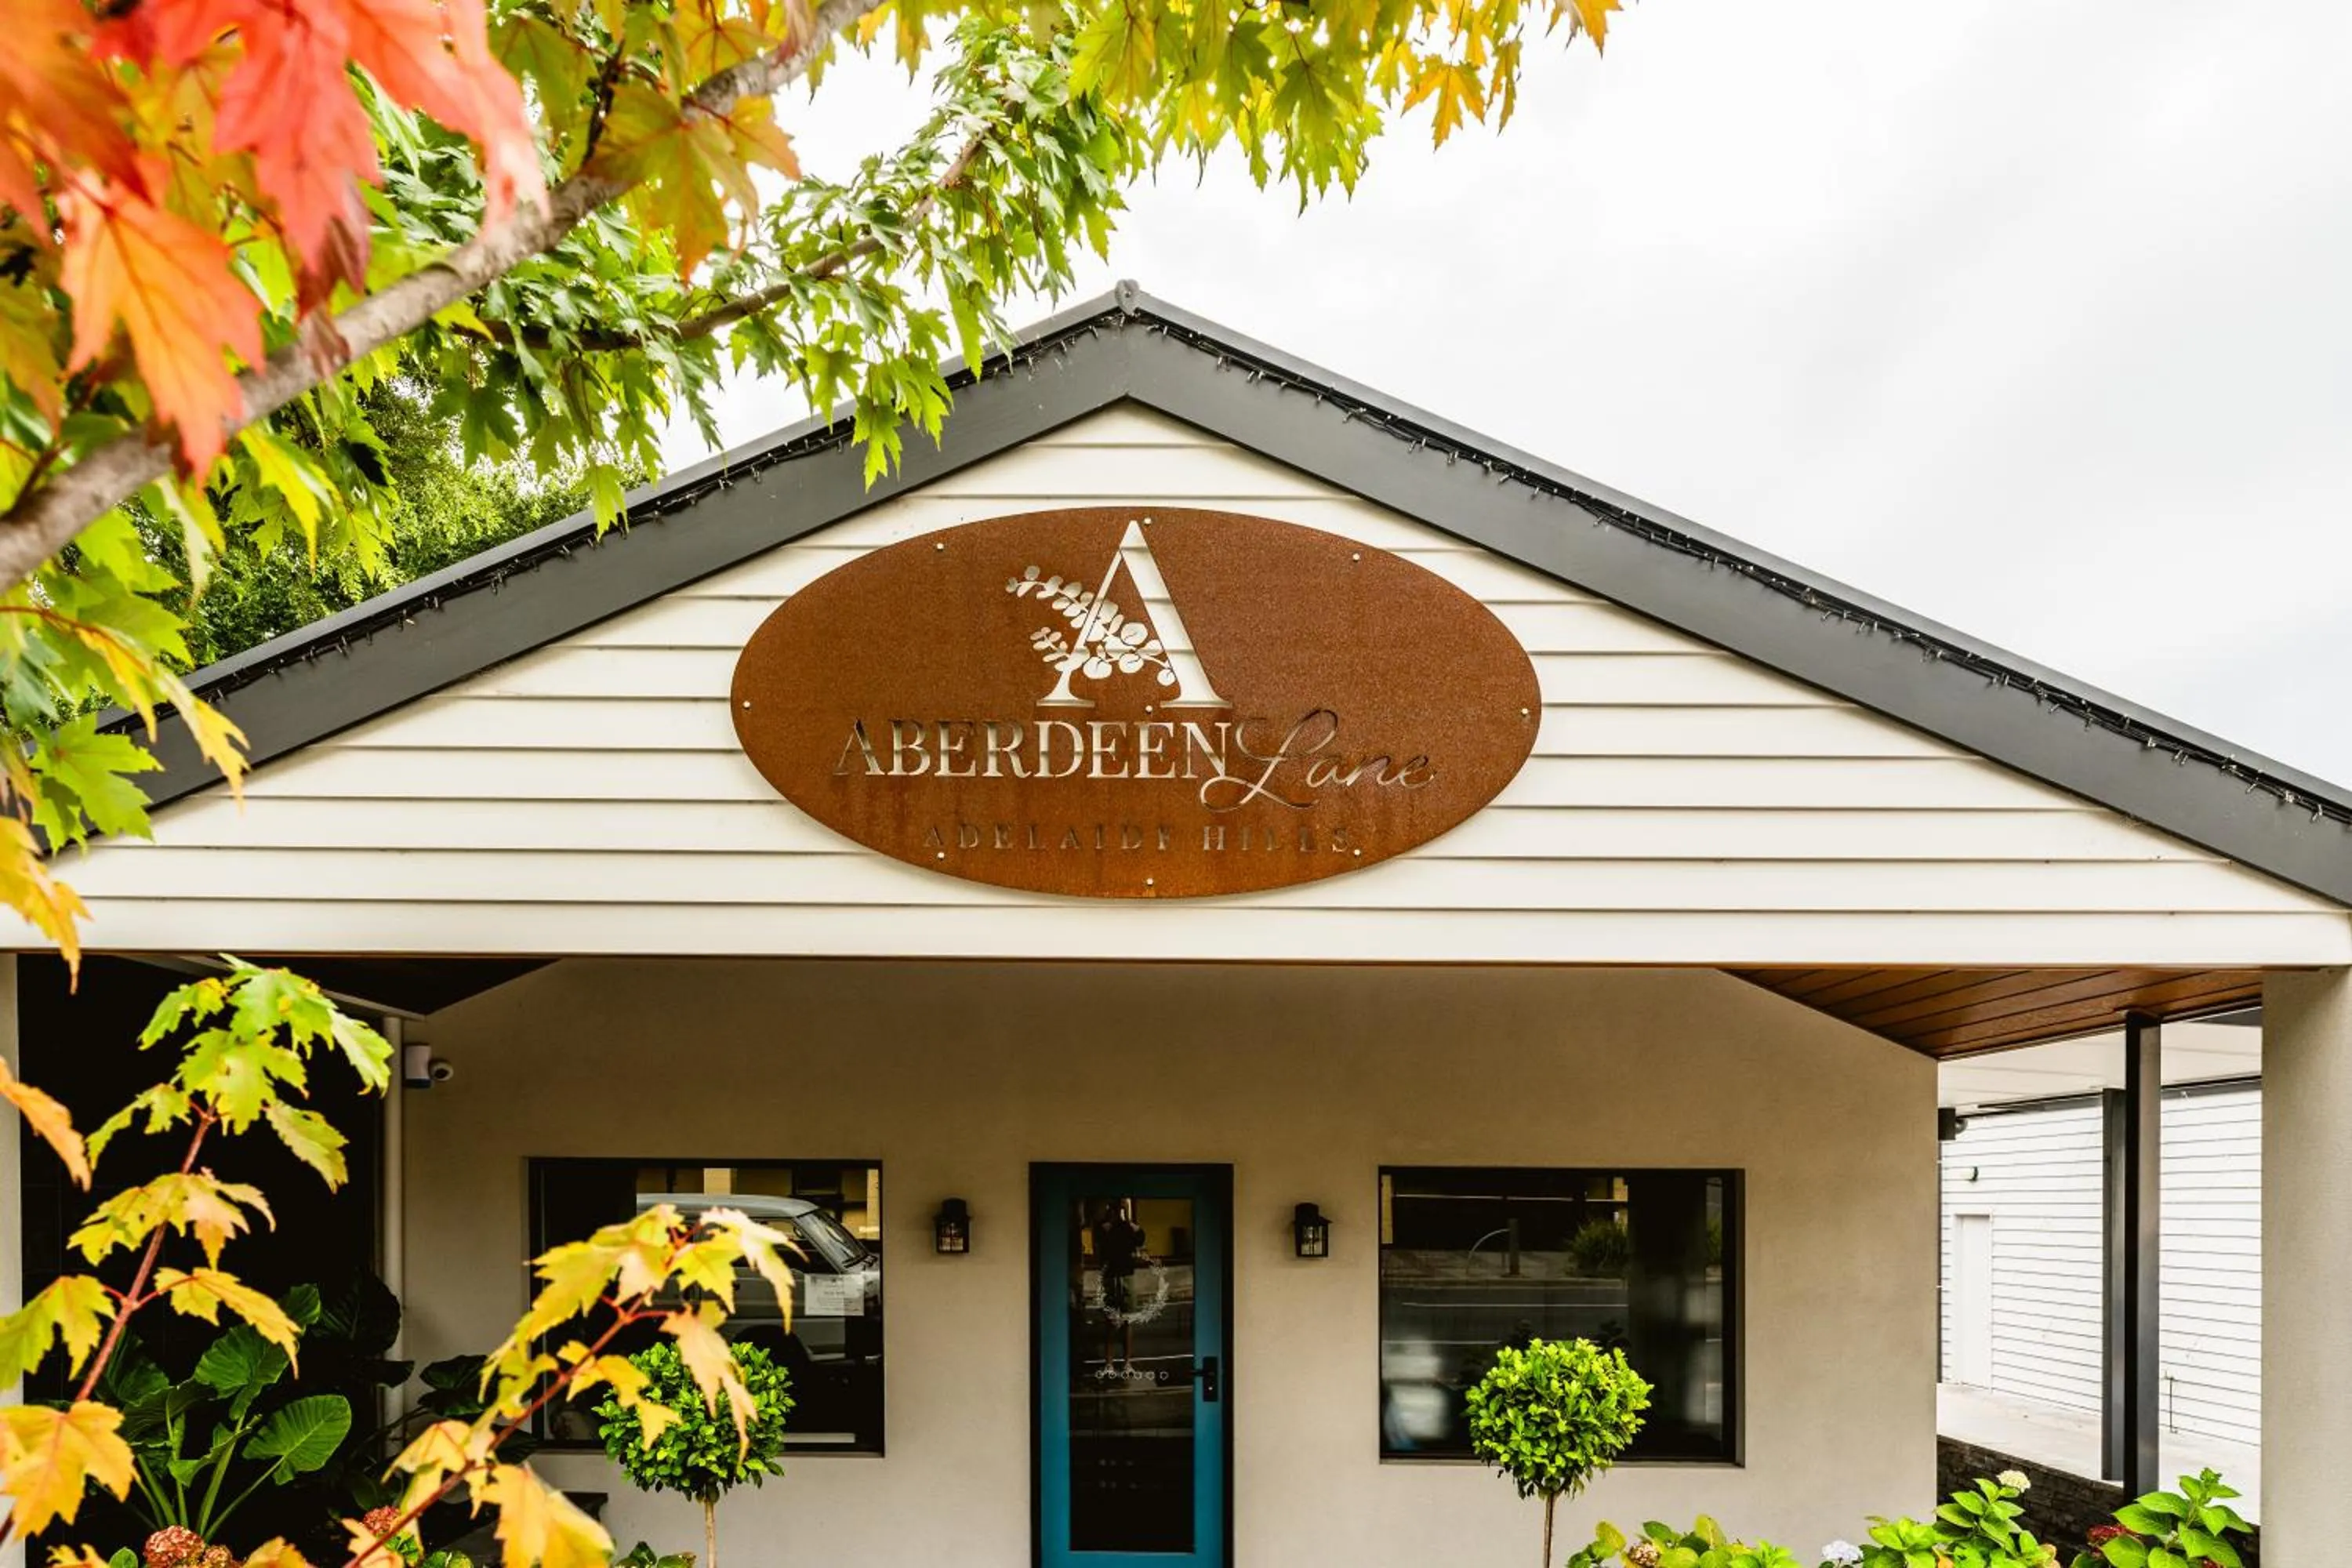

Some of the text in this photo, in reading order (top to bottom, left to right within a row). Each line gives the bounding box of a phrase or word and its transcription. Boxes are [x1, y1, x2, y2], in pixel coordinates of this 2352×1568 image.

[832, 708, 1438, 813] ABERDEEN Lane
[1203, 825, 1348, 852] HILLS
